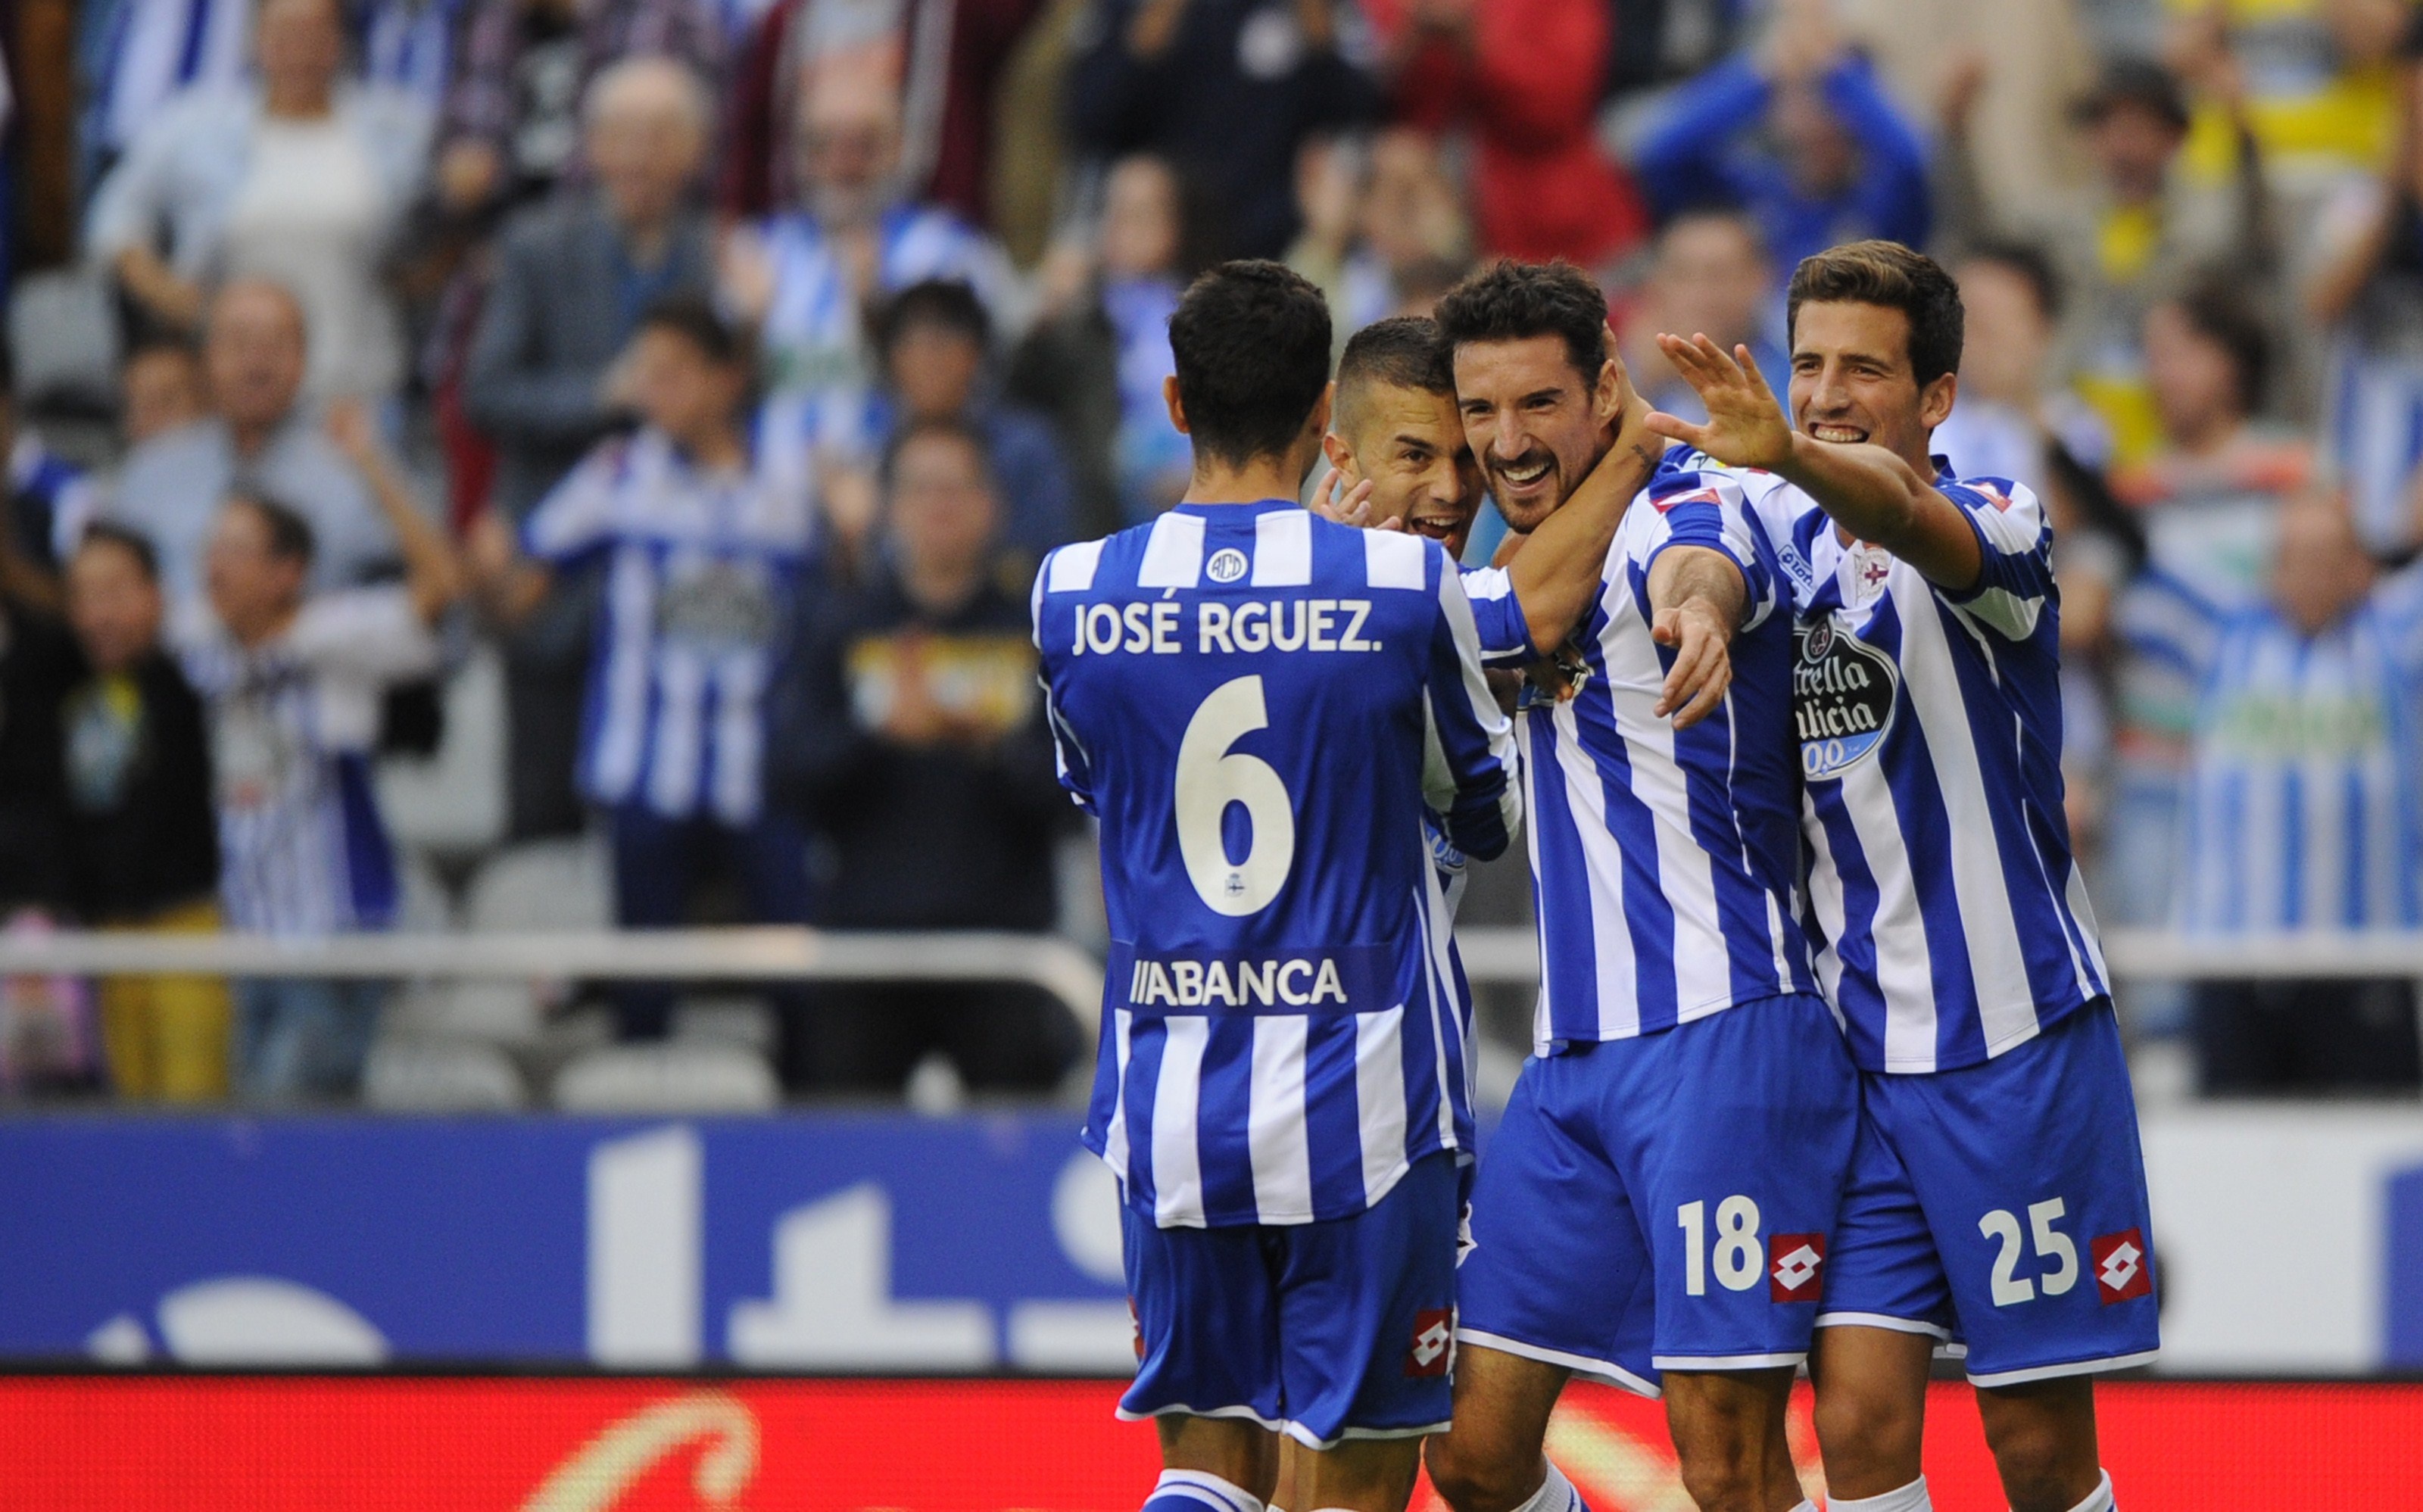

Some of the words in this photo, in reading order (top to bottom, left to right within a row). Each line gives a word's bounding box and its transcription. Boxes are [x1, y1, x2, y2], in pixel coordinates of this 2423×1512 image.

[1072, 586, 1182, 656] JOSÉ
[1198, 599, 1383, 654] RGUEZ.
[1793, 656, 1871, 697] trella
[1174, 674, 1295, 918] 6
[1677, 1195, 1764, 1296] 18
[1978, 1196, 2079, 1308] 25
